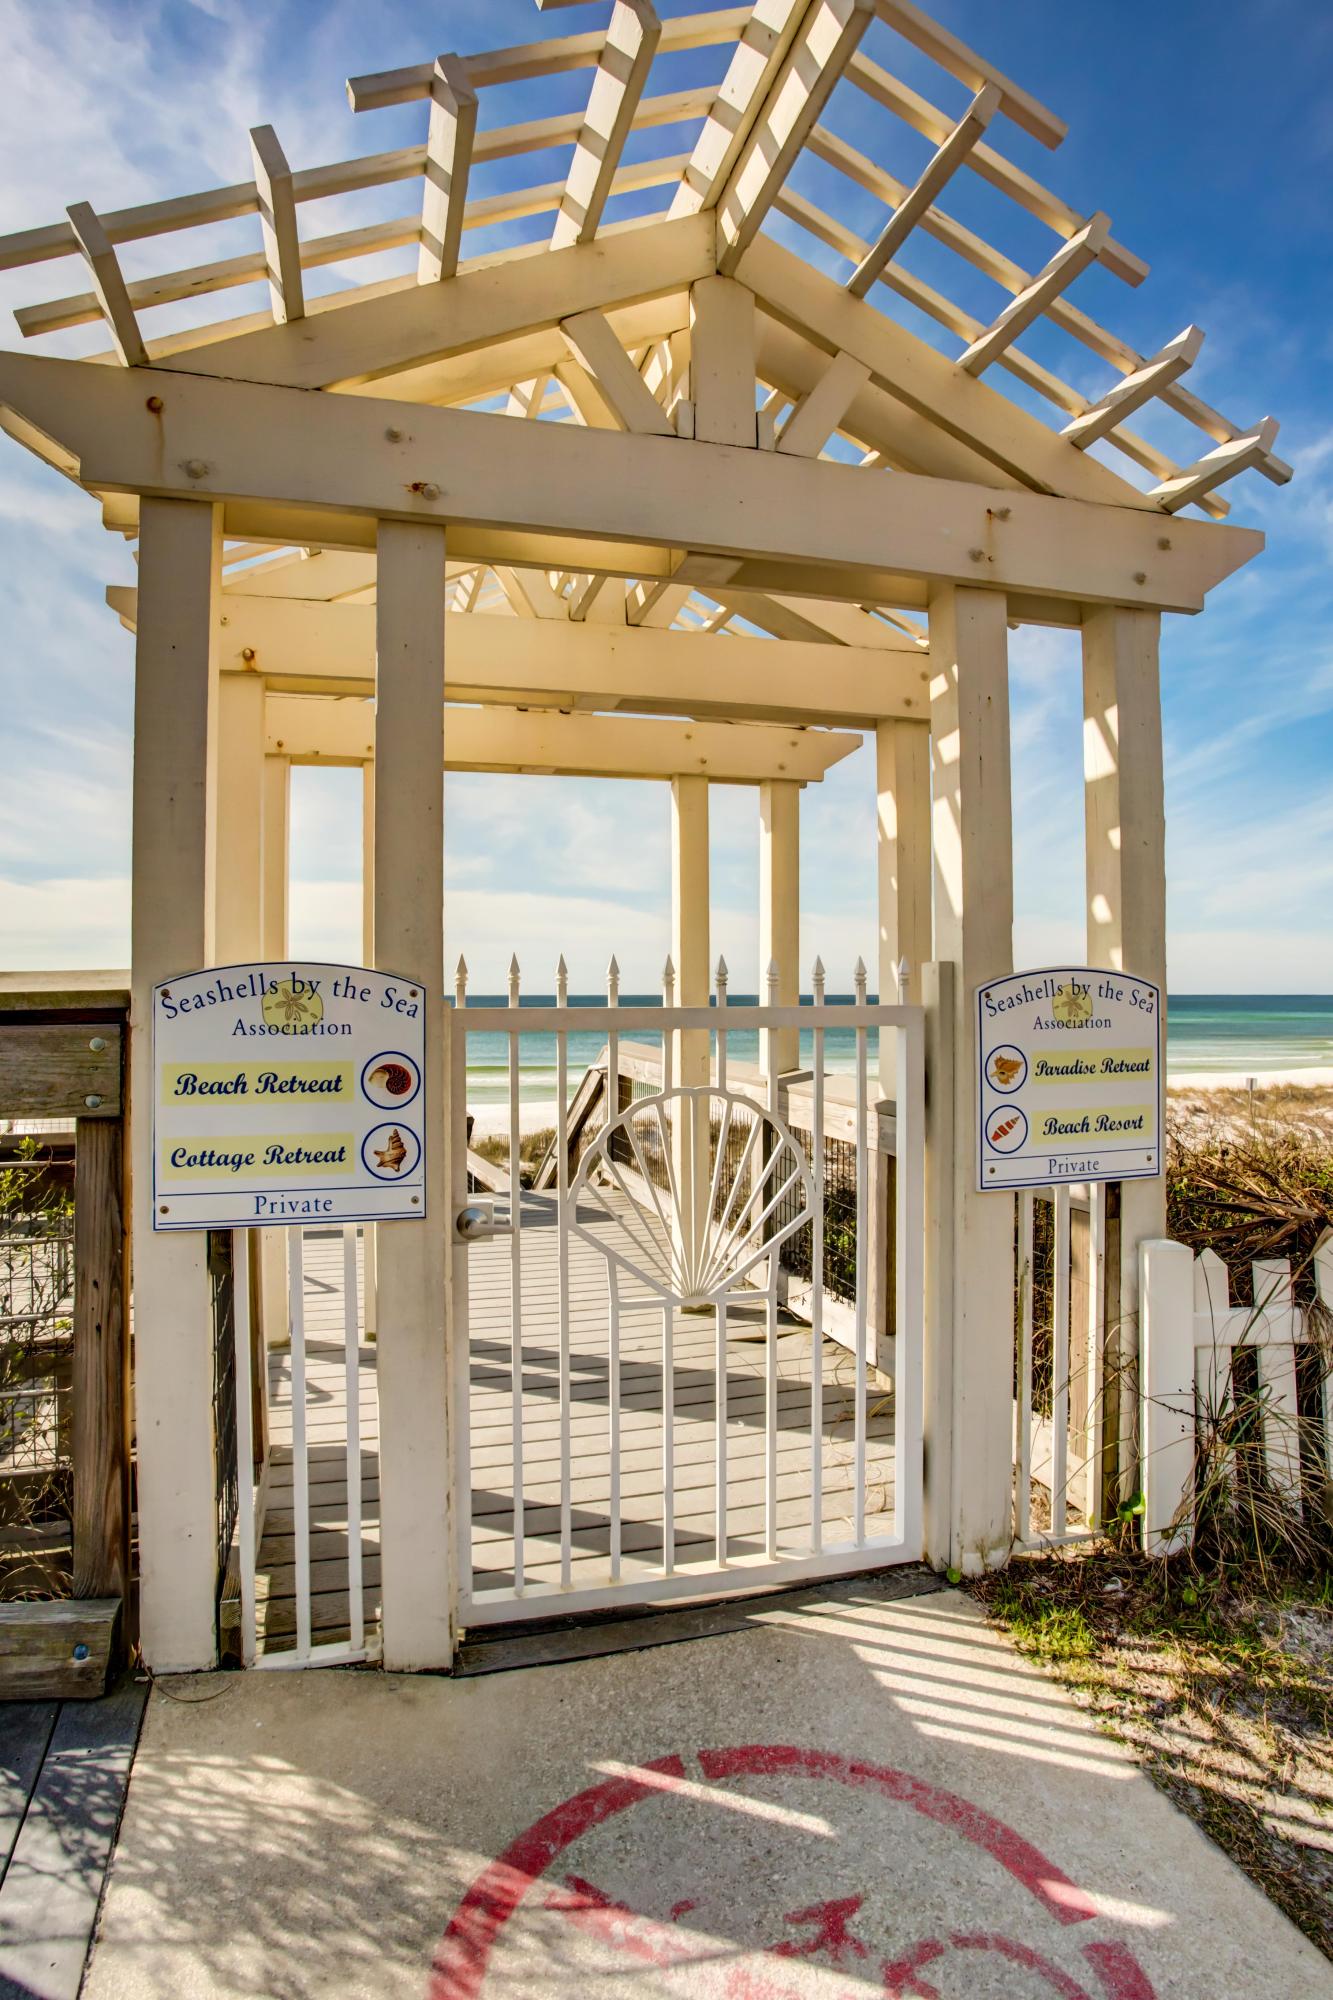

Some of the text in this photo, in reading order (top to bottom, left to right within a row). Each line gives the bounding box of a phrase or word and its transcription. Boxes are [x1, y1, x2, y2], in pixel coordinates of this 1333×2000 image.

[161, 972, 419, 1019] Seashells by the Sea
[985, 977, 1154, 1017] Seashells by the Sea
[232, 1018, 353, 1036] Association
[1033, 1015, 1111, 1029] Association
[1035, 1057, 1150, 1077] Paradise Retreat
[174, 1072, 343, 1096] Beach Retreat
[1043, 1114, 1143, 1135] Beach Resort
[170, 1144, 346, 1172] Cottage Retreat
[1048, 1157, 1100, 1174] Private
[254, 1194, 333, 1215] Private
